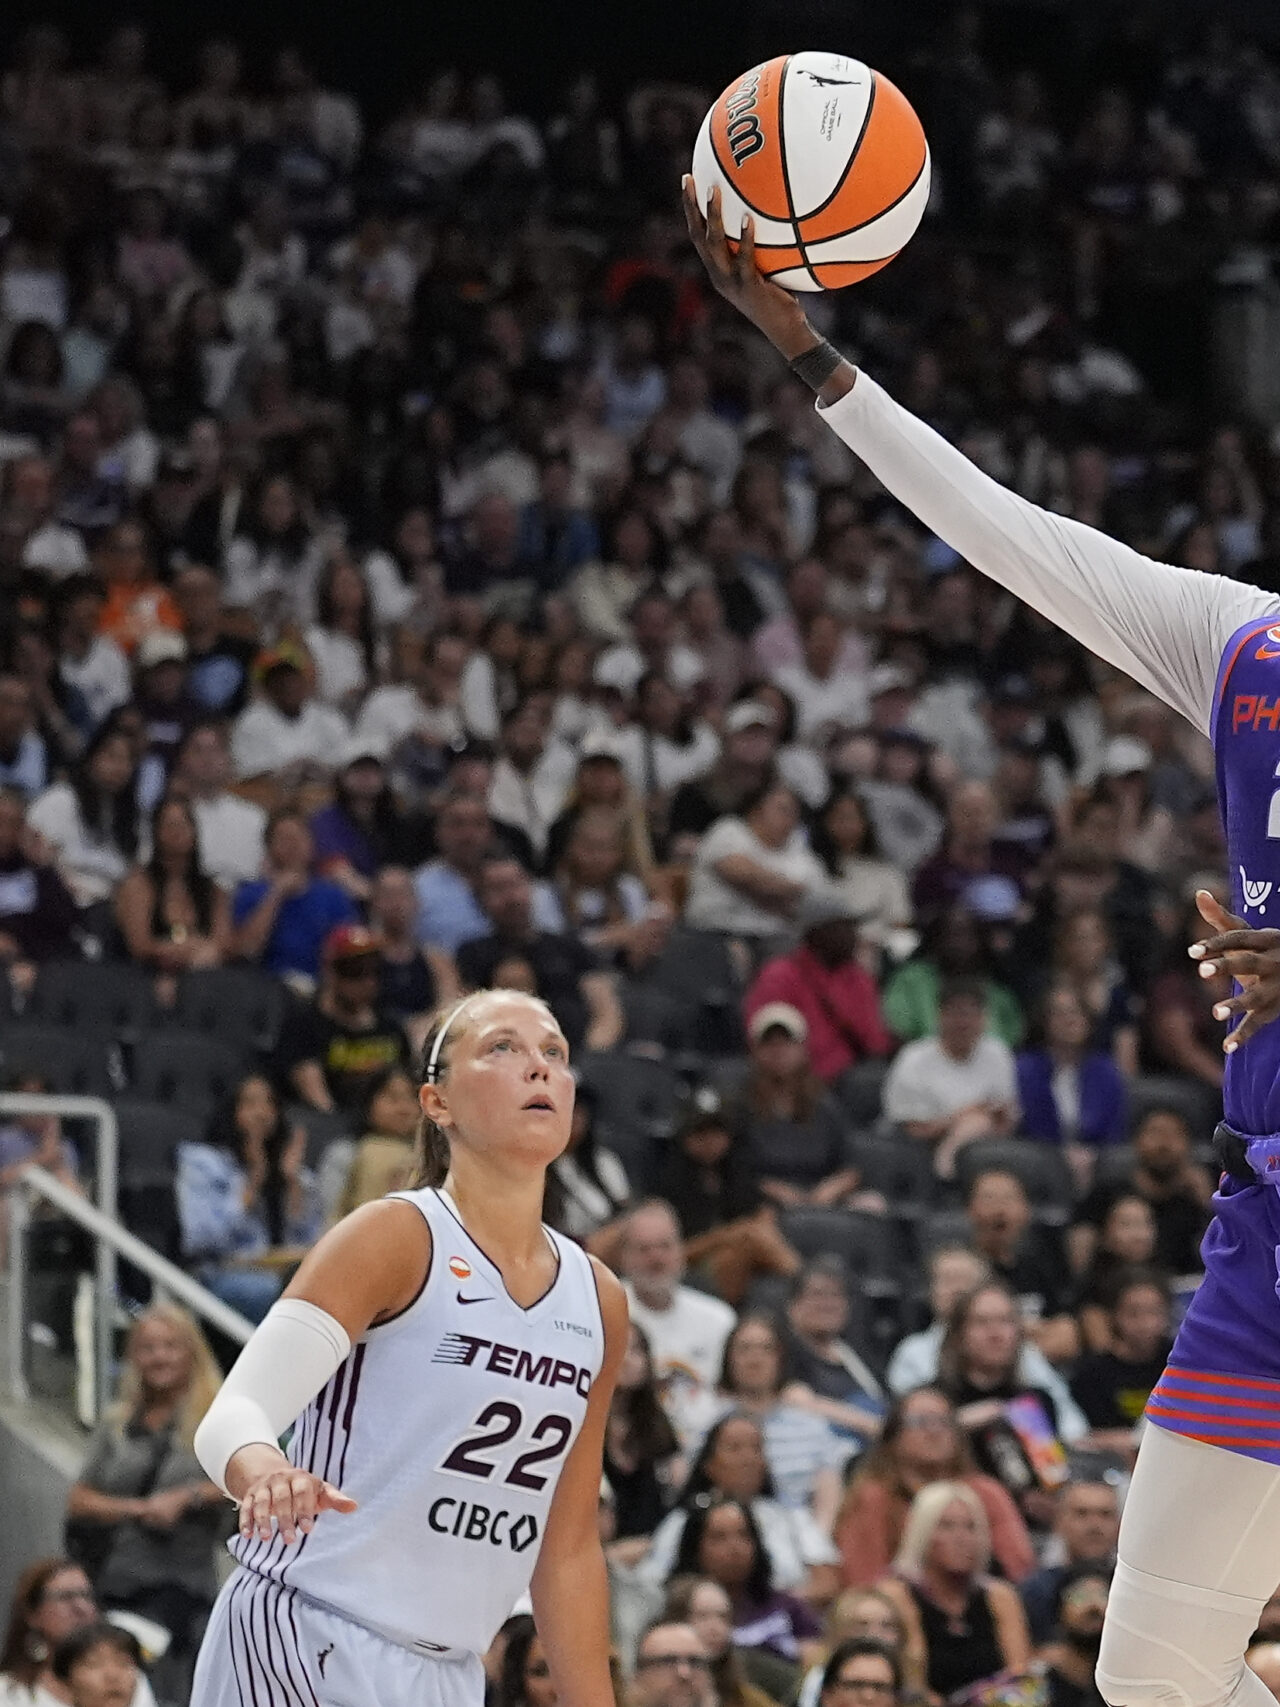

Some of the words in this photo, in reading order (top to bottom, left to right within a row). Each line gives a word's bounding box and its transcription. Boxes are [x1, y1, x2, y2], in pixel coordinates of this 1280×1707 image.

[434, 1332, 592, 1400] TEMPO
[440, 1400, 574, 1494] 22
[428, 1497, 510, 1546] CIBC
